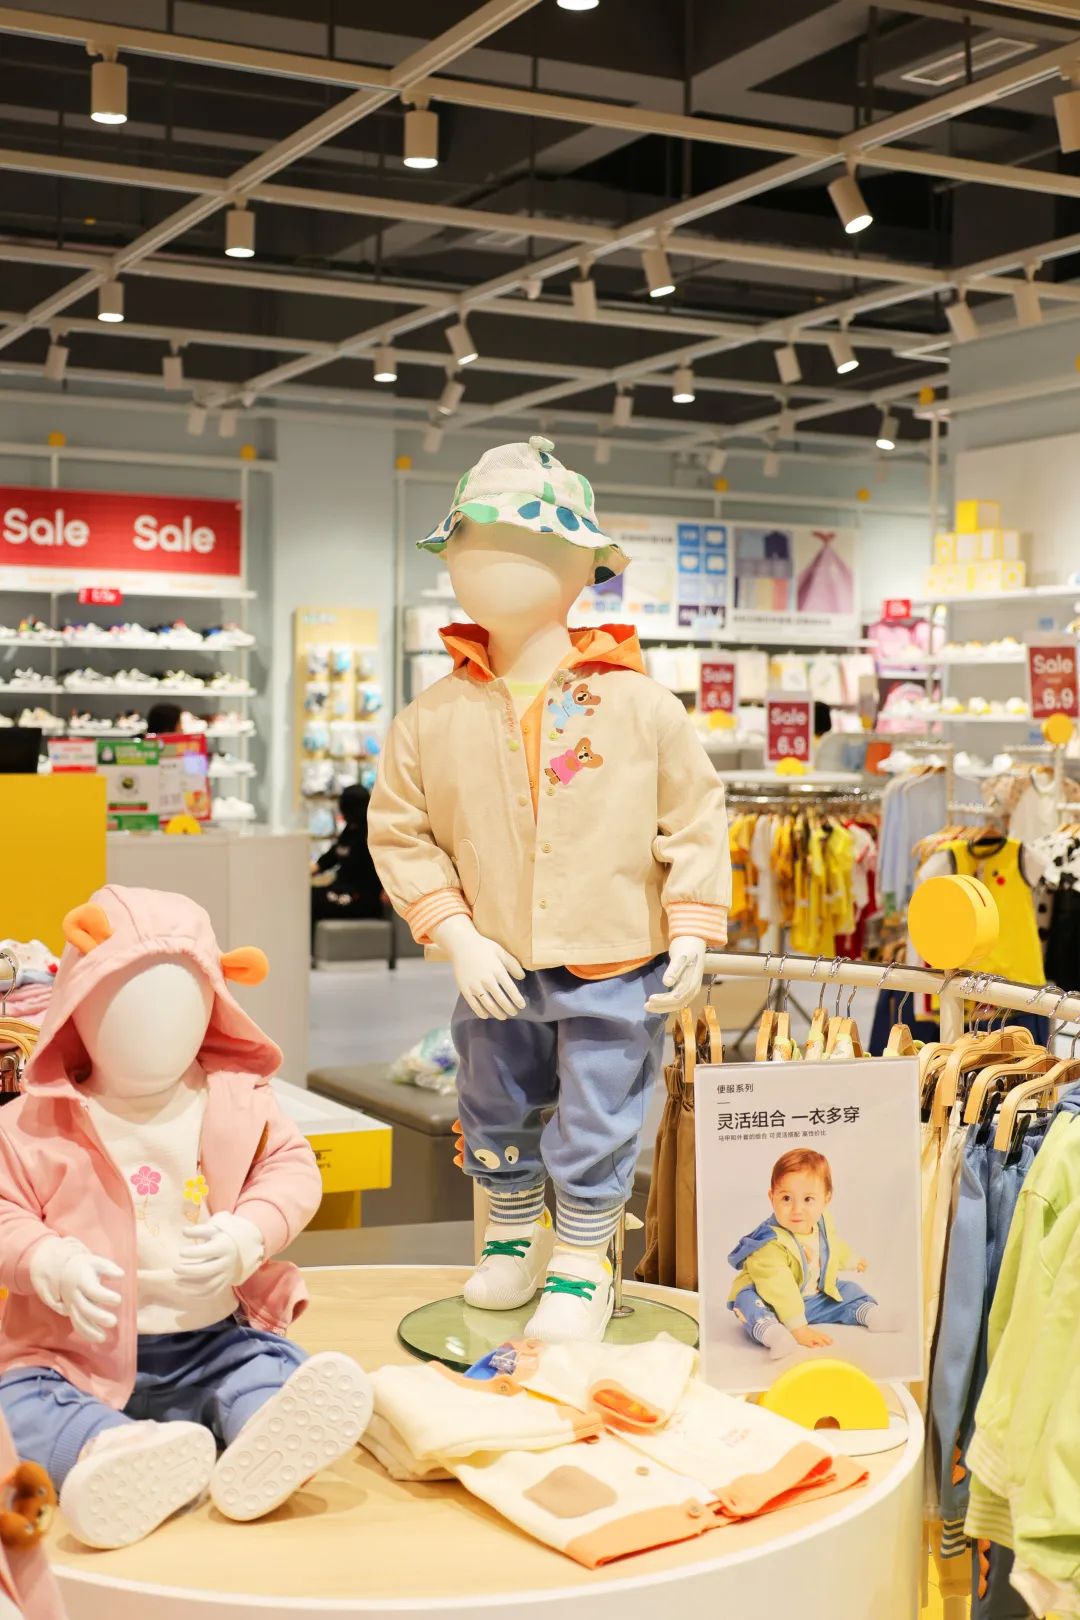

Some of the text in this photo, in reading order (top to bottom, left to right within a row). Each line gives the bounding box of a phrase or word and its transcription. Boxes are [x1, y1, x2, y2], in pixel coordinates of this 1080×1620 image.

[3, 507, 90, 548] Sale
[133, 514, 216, 554] Sale
[702, 666, 732, 683] Sale
[1033, 653, 1073, 675] Sale
[1042, 687, 1074, 710] 6.9
[770, 706, 807, 726] Sale
[777, 735, 806, 756] 6.9
[716, 1083, 754, 1095] 便服系列
[717, 1106, 860, 1131] 灵活组合 一衣多穿
[769, 1130, 800, 1140] 可灵活搭配
[801, 1128, 827, 1138] 高性价比
